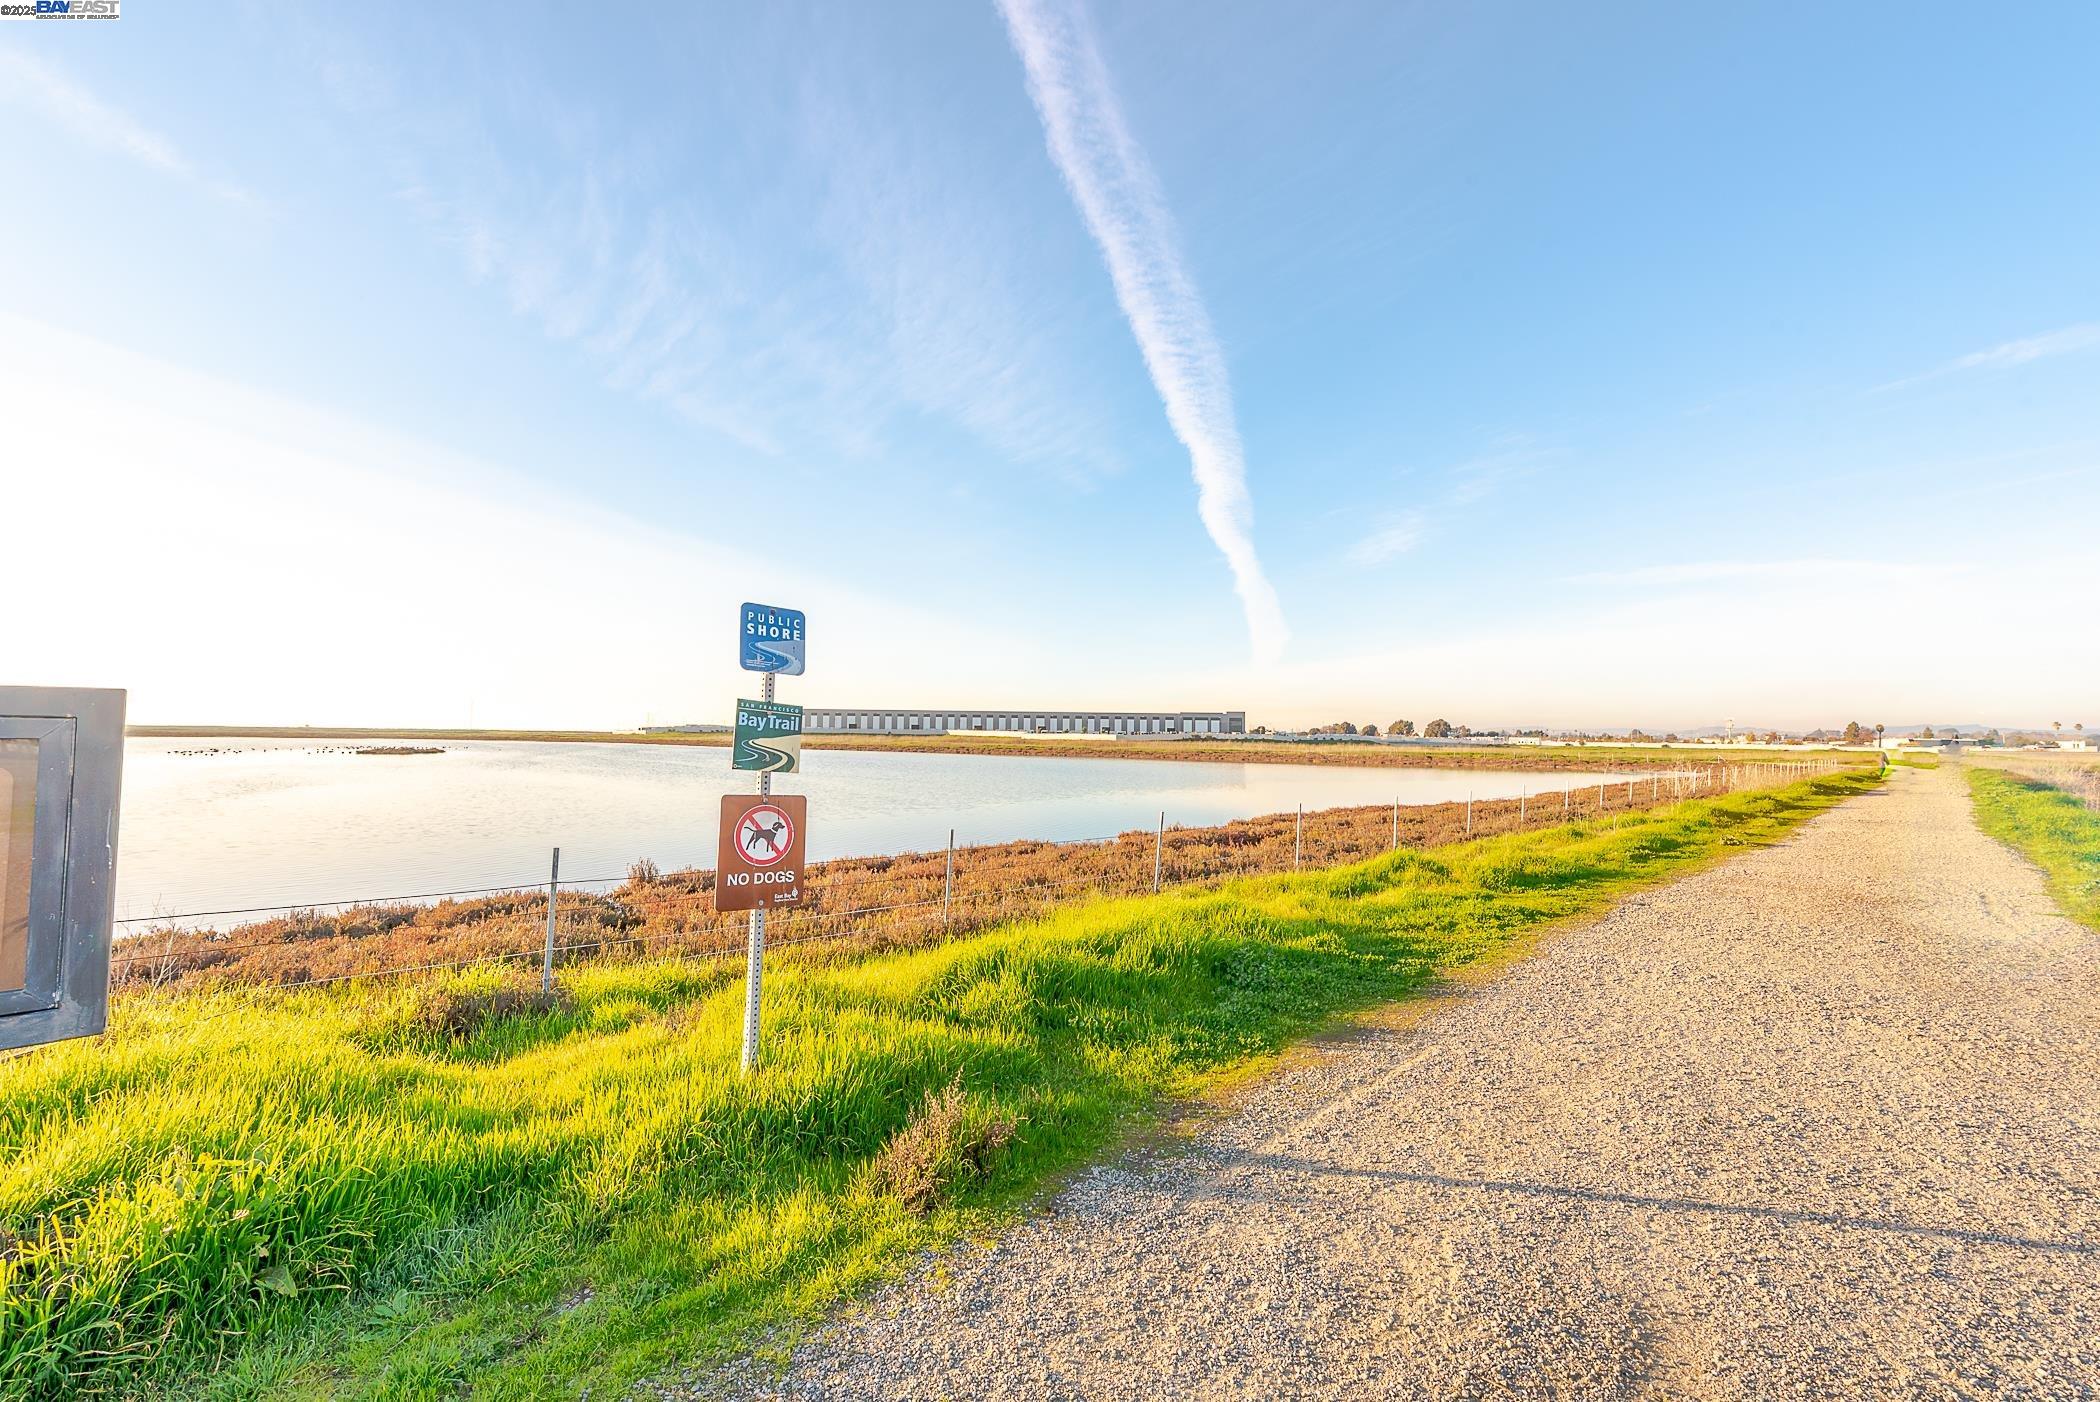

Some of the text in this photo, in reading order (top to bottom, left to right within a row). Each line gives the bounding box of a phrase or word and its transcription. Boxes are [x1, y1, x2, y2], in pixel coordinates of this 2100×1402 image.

[748, 612, 800, 628] PUBLIC
[746, 623, 800, 641] SHORE
[759, 705, 799, 713] FRANCISCO
[727, 871, 794, 887] NO DOGS
